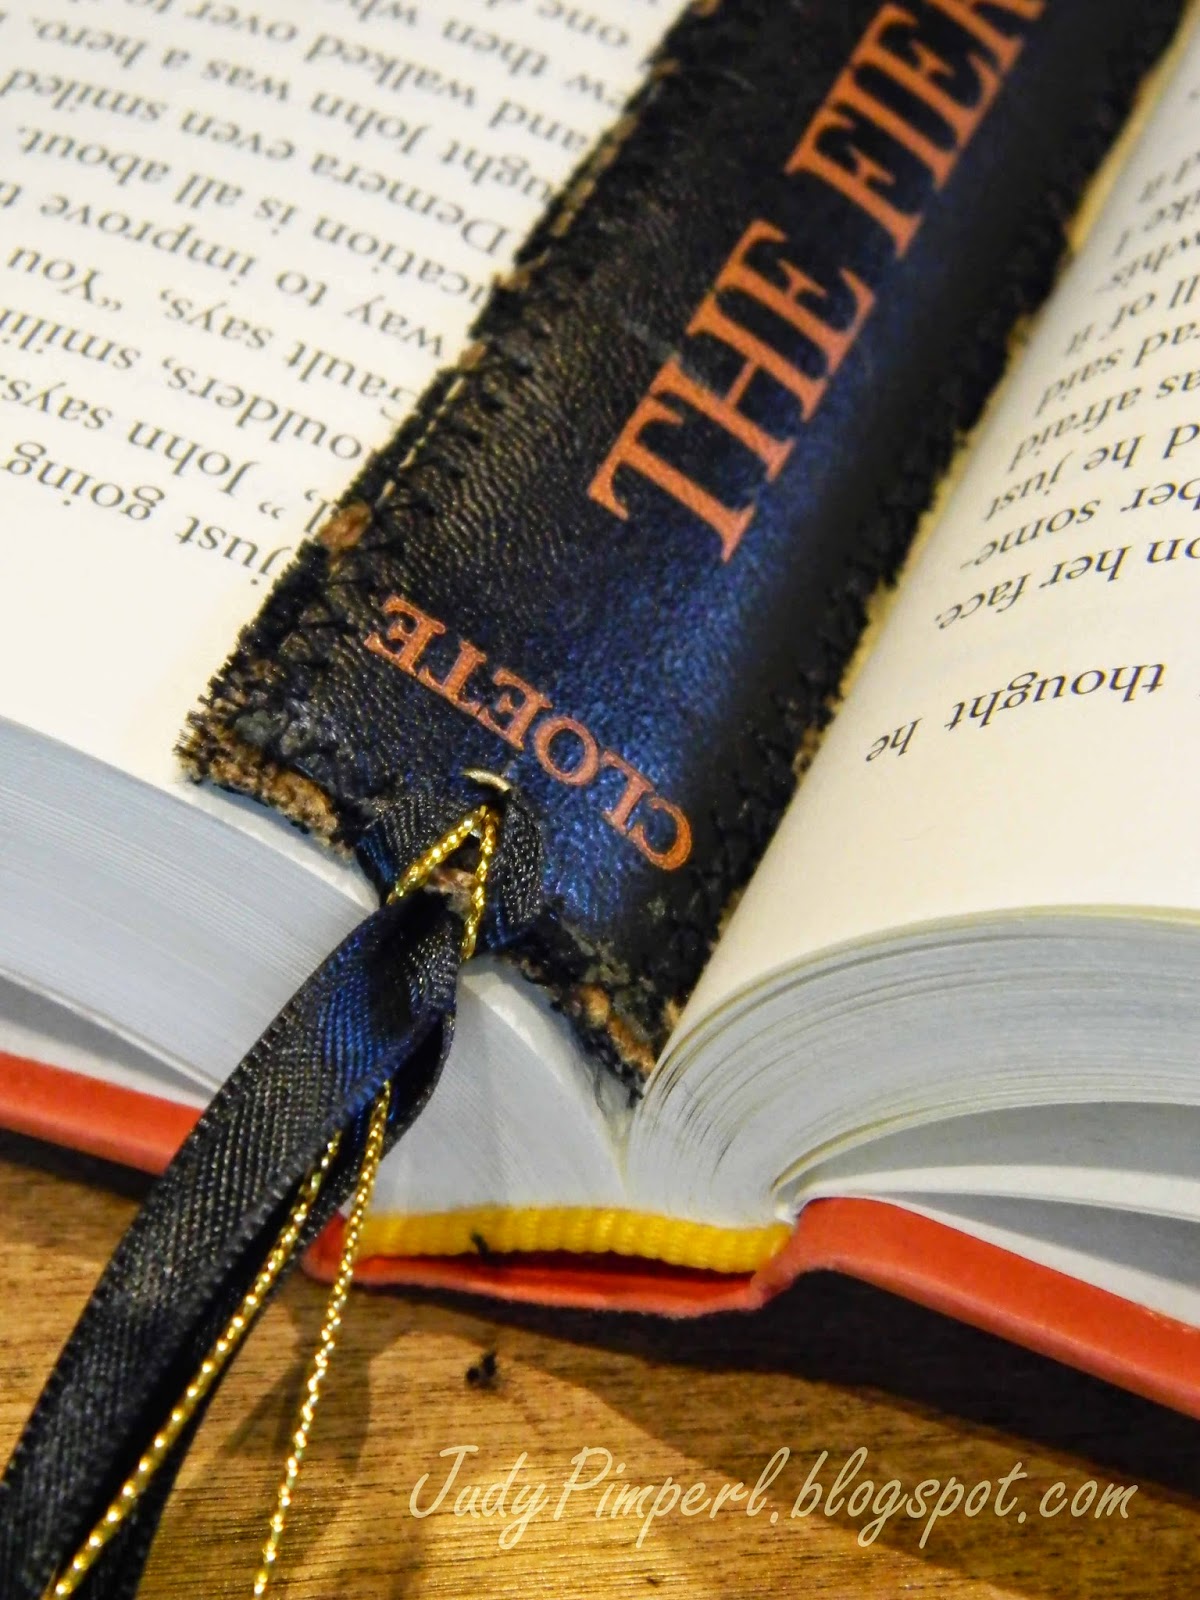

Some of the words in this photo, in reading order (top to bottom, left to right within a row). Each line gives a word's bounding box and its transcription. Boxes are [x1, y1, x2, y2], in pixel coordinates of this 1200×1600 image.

[185, 0, 298, 44] over
[442, 20, 549, 77] then
[162, 49, 190, 70] a
[202, 60, 290, 103] was
[304, 34, 476, 108] walked
[0, 70, 168, 124] smiled
[310, 92, 432, 156] John
[18, 126, 171, 186] about.
[180, 112, 296, 162] even
[488, 101, 590, 154] and
[174, 173, 243, 210] all
[255, 198, 297, 236] is
[310, 153, 510, 255] Demera
[39, 196, 256, 286] improve
[276, 272, 328, 307] to
[1099, 294, 1156, 341] of
[0, 310, 141, 371] smili
[161, 290, 274, 350] says,
[345, 295, 445, 360] way
[587, 218, 876, 563] THE
[1035, 348, 1123, 417] said
[127, 422, 259, 496] John
[1008, 388, 1142, 474] afraid
[1083, 436, 1145, 470] he
[0, 442, 166, 521] going
[984, 451, 1073, 522] just
[175, 516, 292, 586] just
[959, 500, 1102, 570] some-
[1038, 546, 1133, 589] her
[934, 574, 1032, 631] face.
[944, 664, 1166, 732] thought
[364, 595, 693, 872] CLOETE
[865, 717, 924, 762] he
